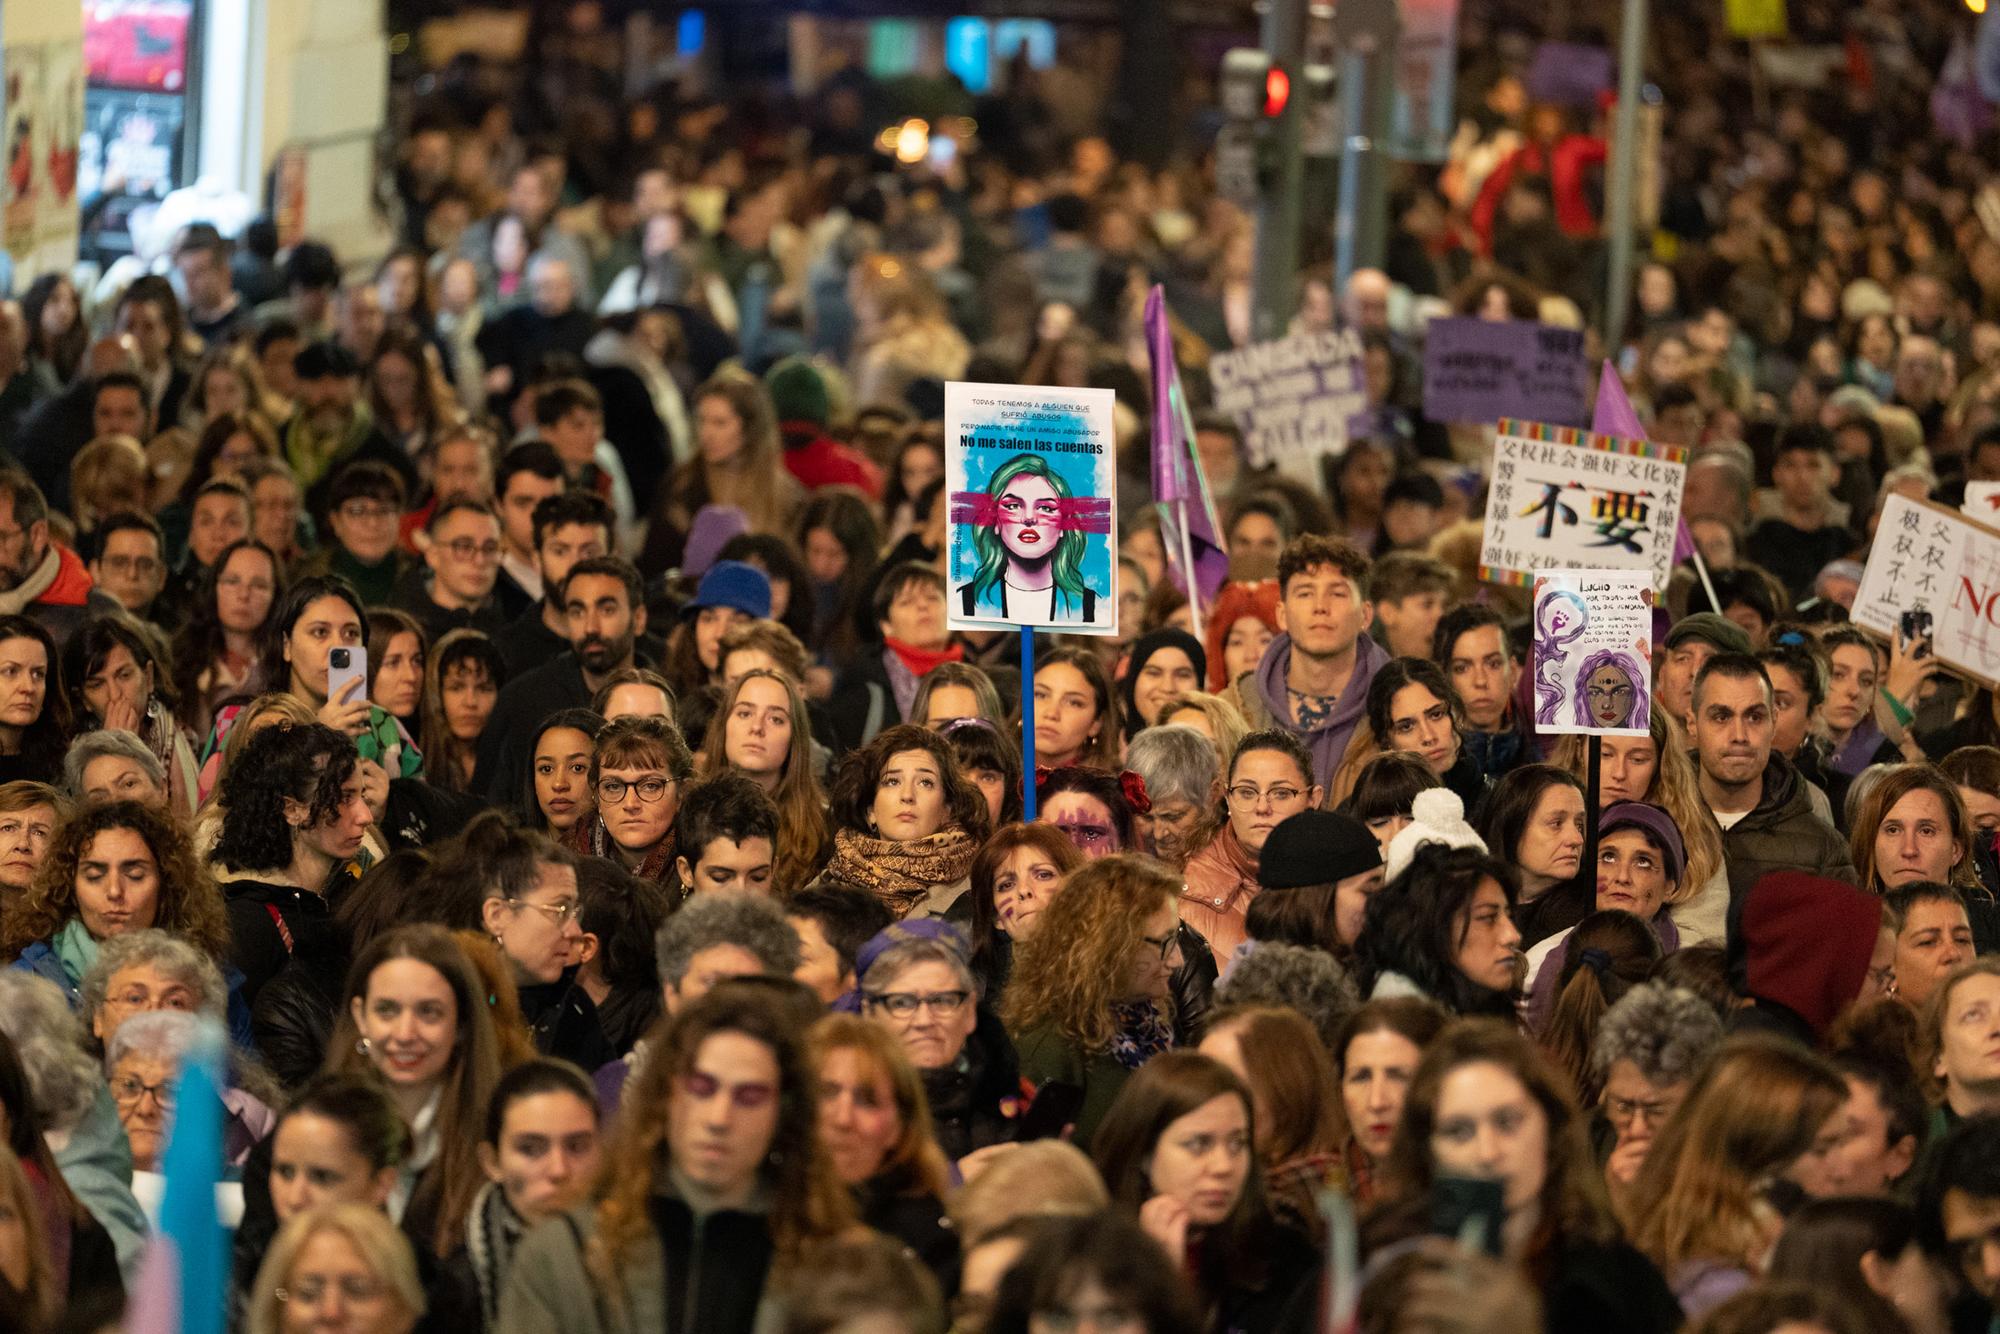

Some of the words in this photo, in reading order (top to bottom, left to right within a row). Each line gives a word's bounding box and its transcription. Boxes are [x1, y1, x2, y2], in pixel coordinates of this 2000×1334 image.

[960, 435, 975, 447] No
[978, 437, 995, 448] me
[999, 438, 1031, 450] salen
[1035, 439, 1052, 451] las
[1055, 442, 1103, 454] cuentas
[1516, 478, 1655, 555] 不要
